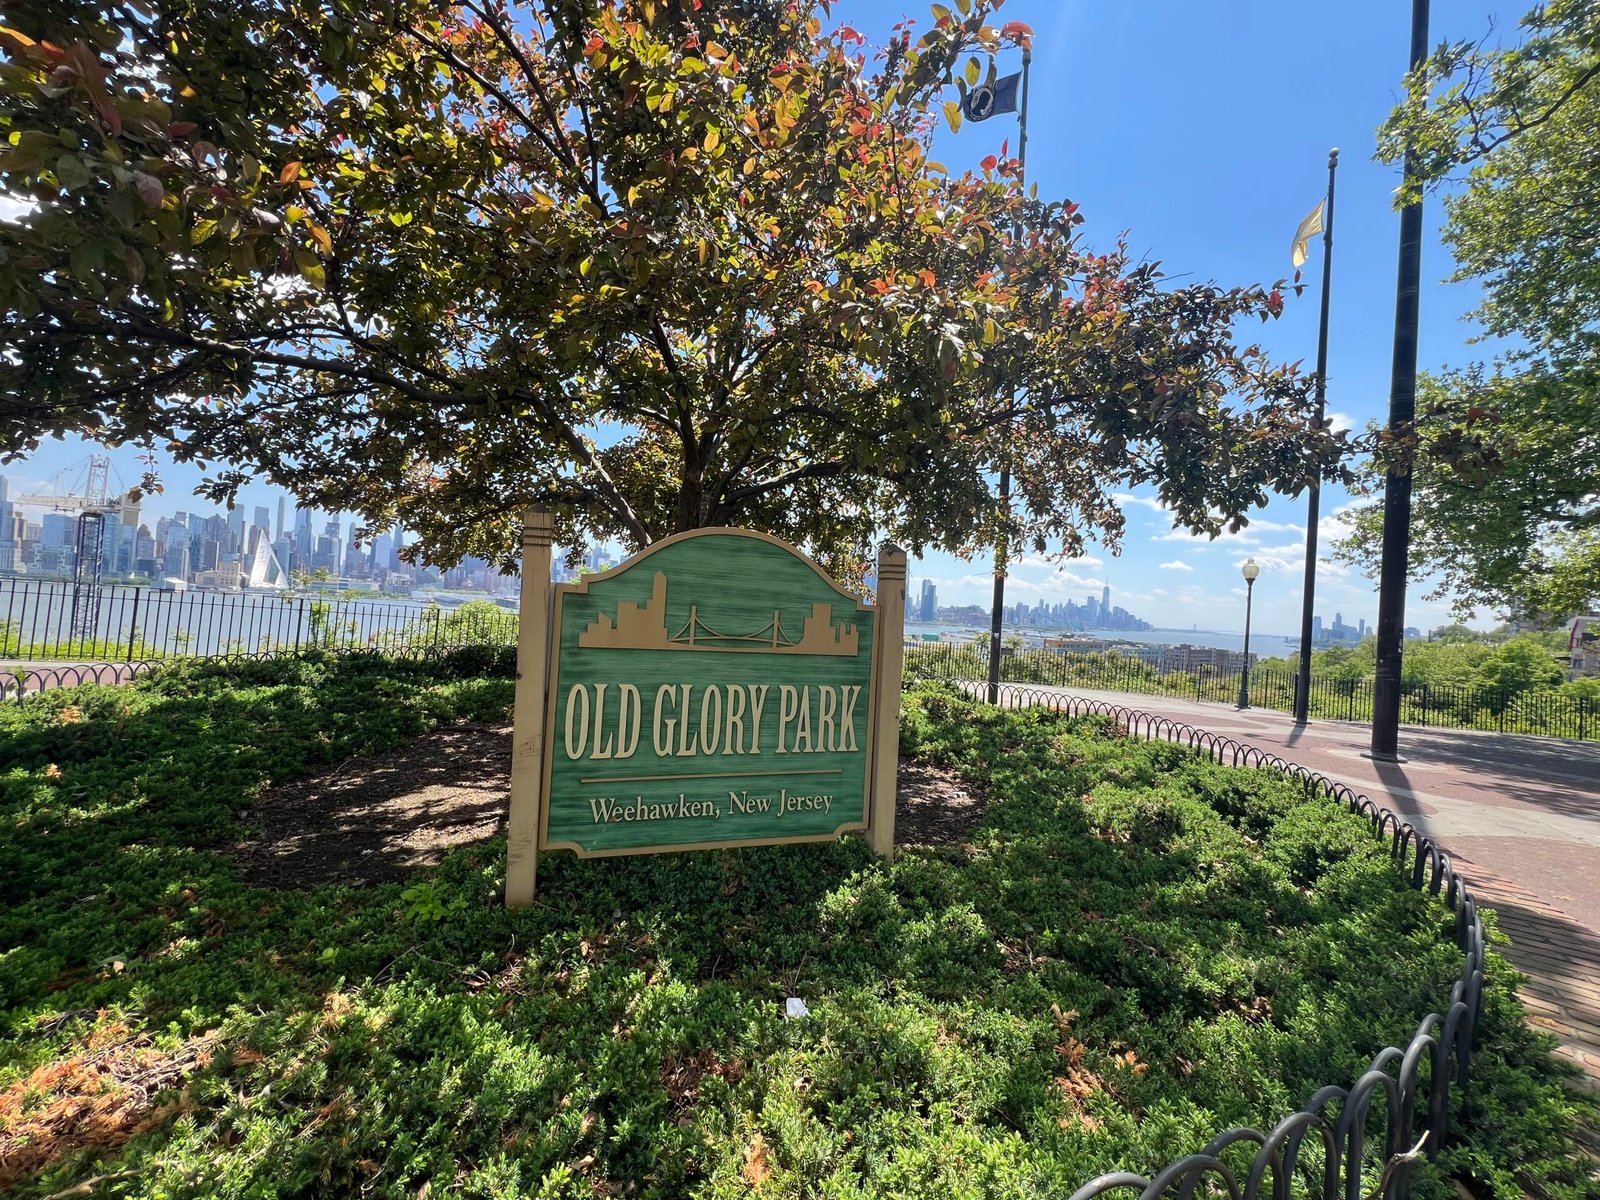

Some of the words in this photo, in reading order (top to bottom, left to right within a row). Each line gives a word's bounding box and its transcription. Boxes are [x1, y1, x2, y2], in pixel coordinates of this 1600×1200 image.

[565, 683, 641, 760] OLD
[653, 684, 770, 757] GLORY
[775, 685, 862, 753] PARK
[589, 793, 721, 824] Weehawken,
[728, 791, 772, 815] New
[777, 789, 833, 817] Jersey
